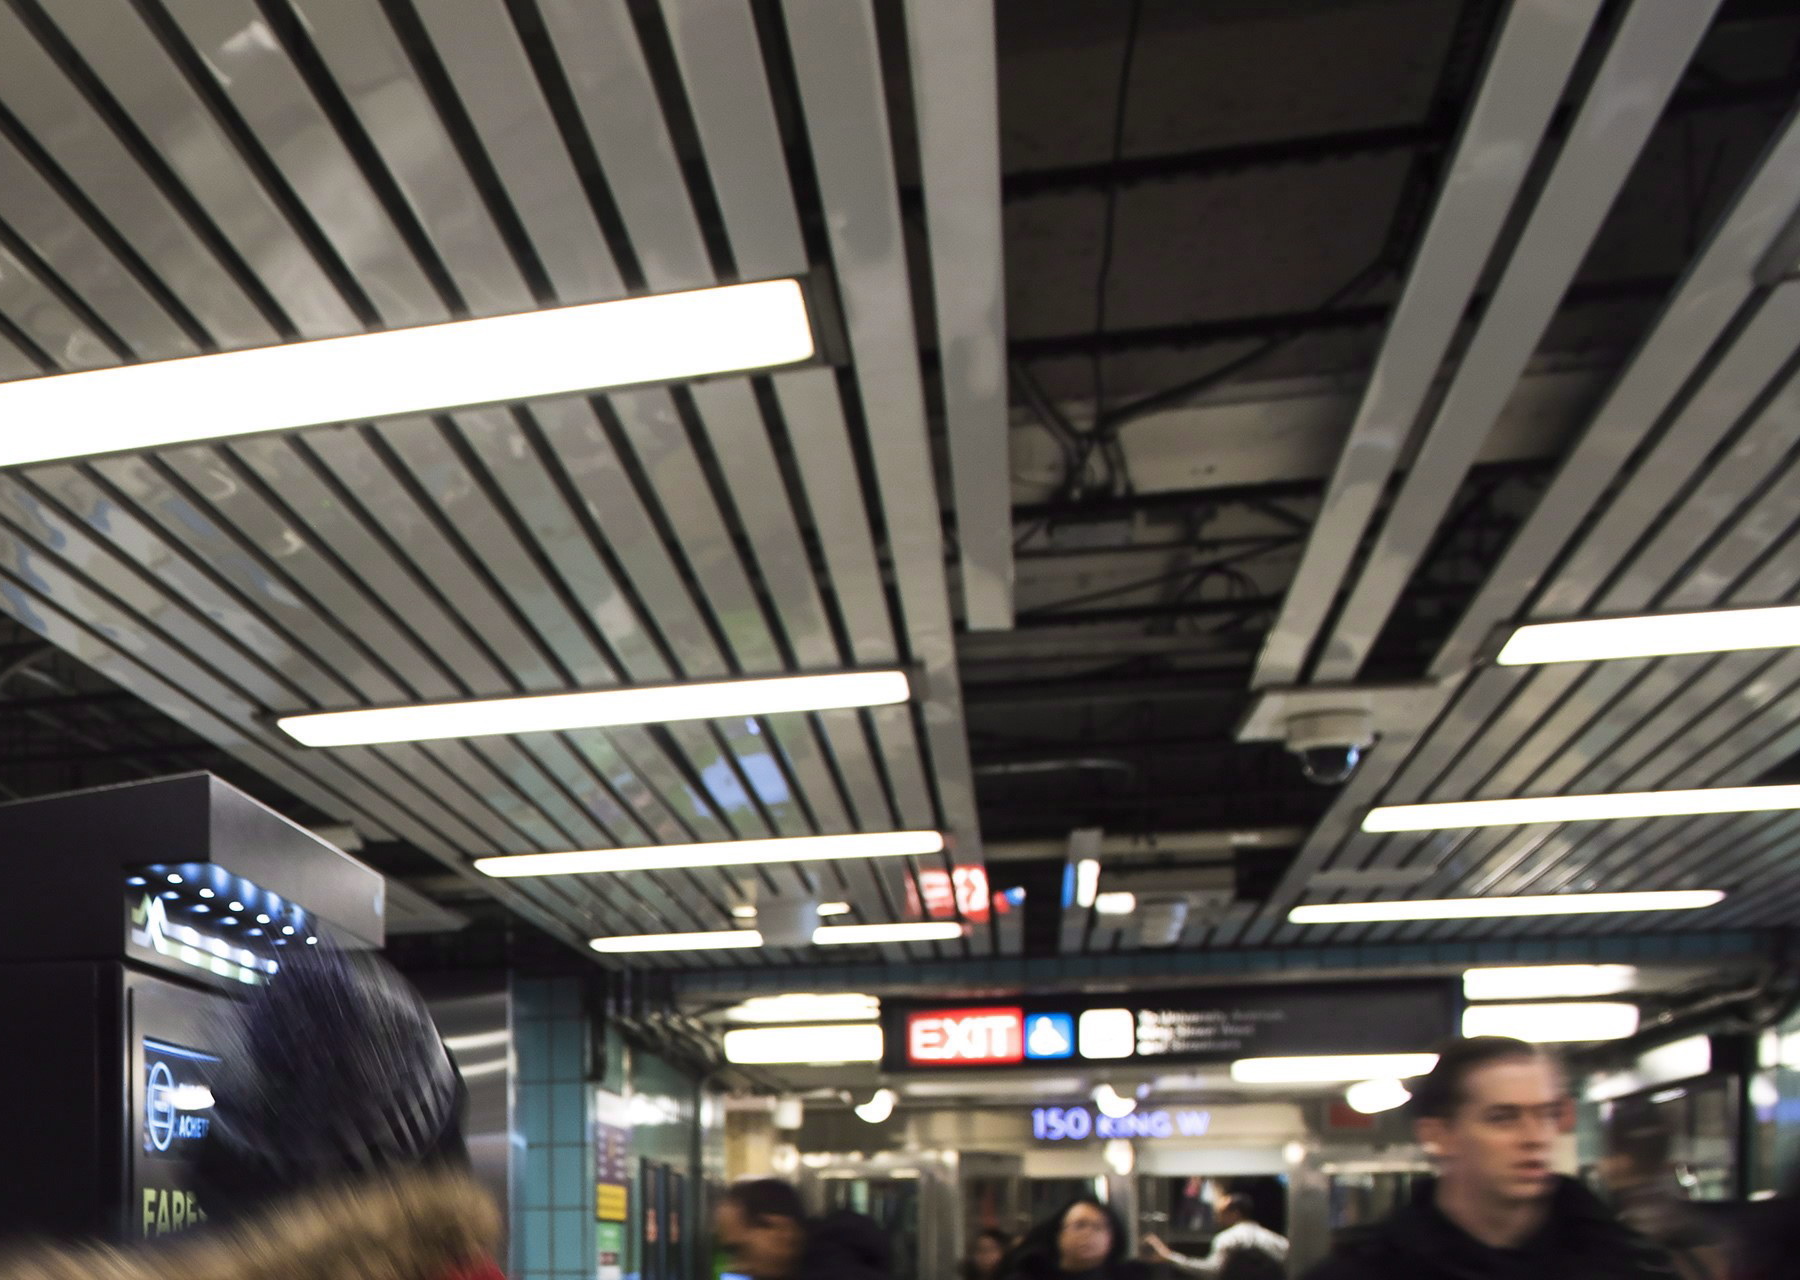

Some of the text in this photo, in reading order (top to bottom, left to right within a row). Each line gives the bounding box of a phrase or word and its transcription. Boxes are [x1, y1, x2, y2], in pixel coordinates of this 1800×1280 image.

[910, 1014, 1020, 1060] EXIT
[1032, 1106, 1090, 1140] 150
[1095, 1110, 1172, 1139] KING
